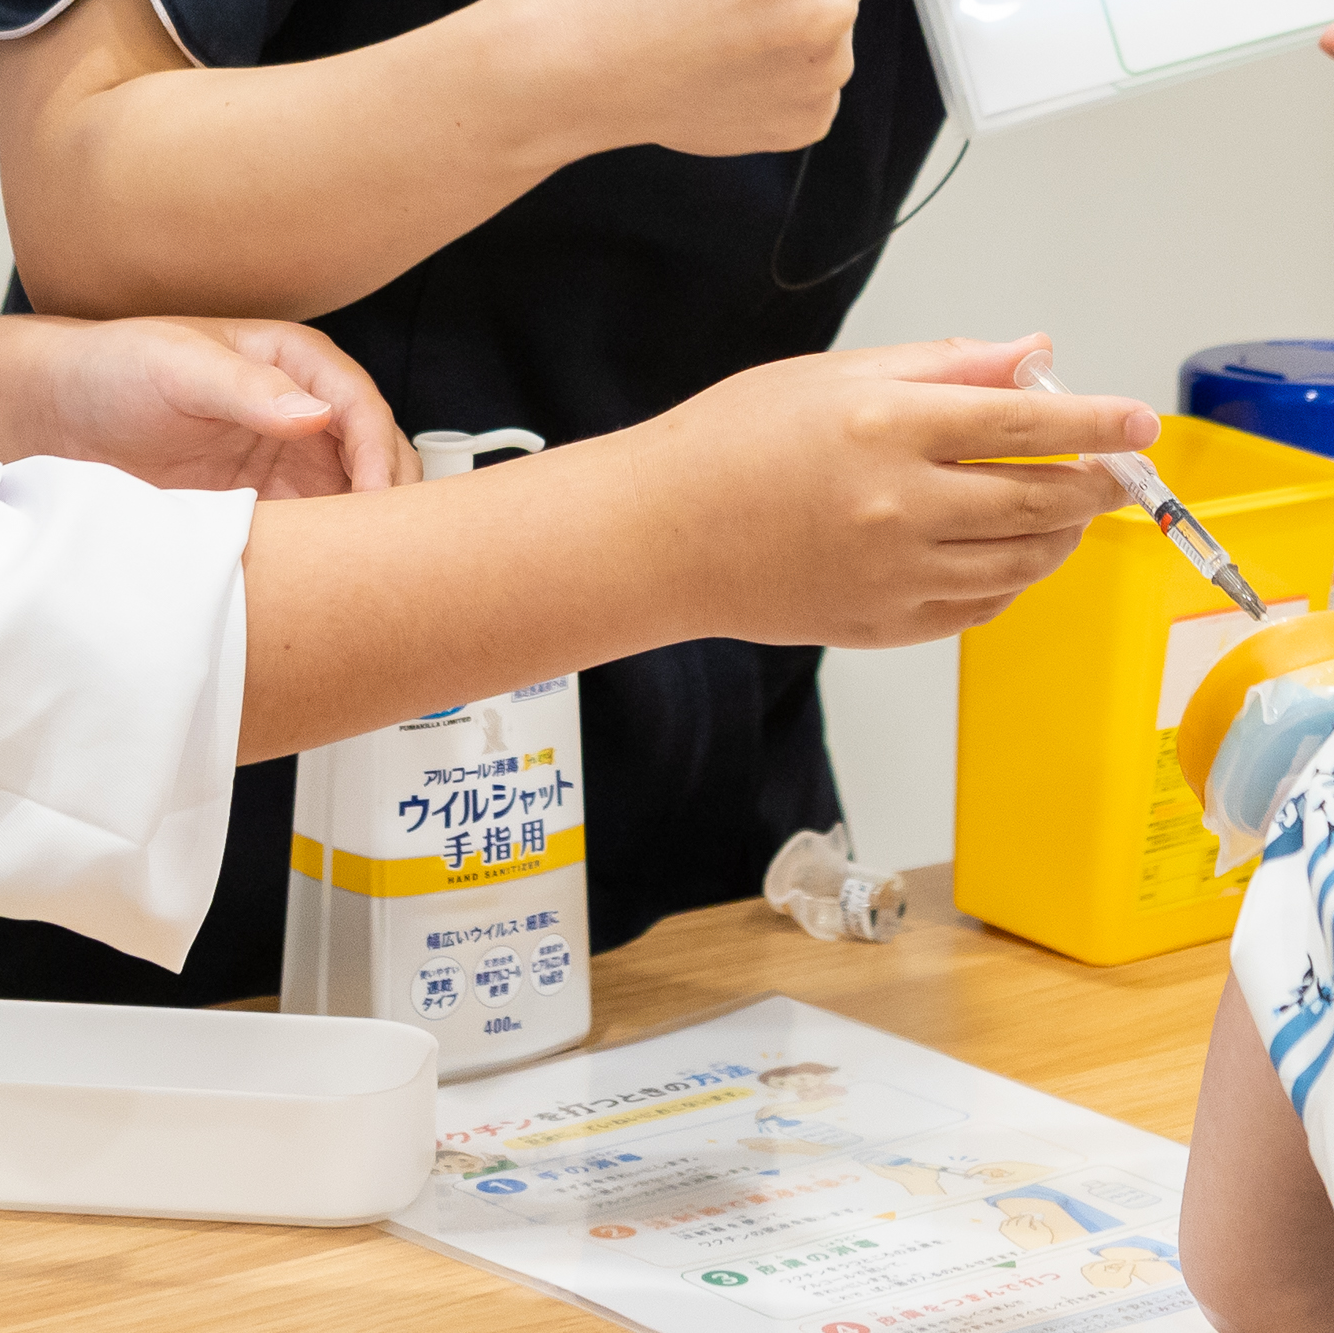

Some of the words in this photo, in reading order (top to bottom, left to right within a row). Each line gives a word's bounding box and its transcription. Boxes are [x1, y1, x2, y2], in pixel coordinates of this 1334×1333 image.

[424, 756, 519, 787] アルコール消毒
[399, 769, 574, 833] ウイルシャット
[443, 818, 545, 869] 手指用
[447, 873, 478, 884] HAND
[484, 860, 540, 879] SANITIZER
[436, 1063, 756, 1148] クチンを打つときの方法
